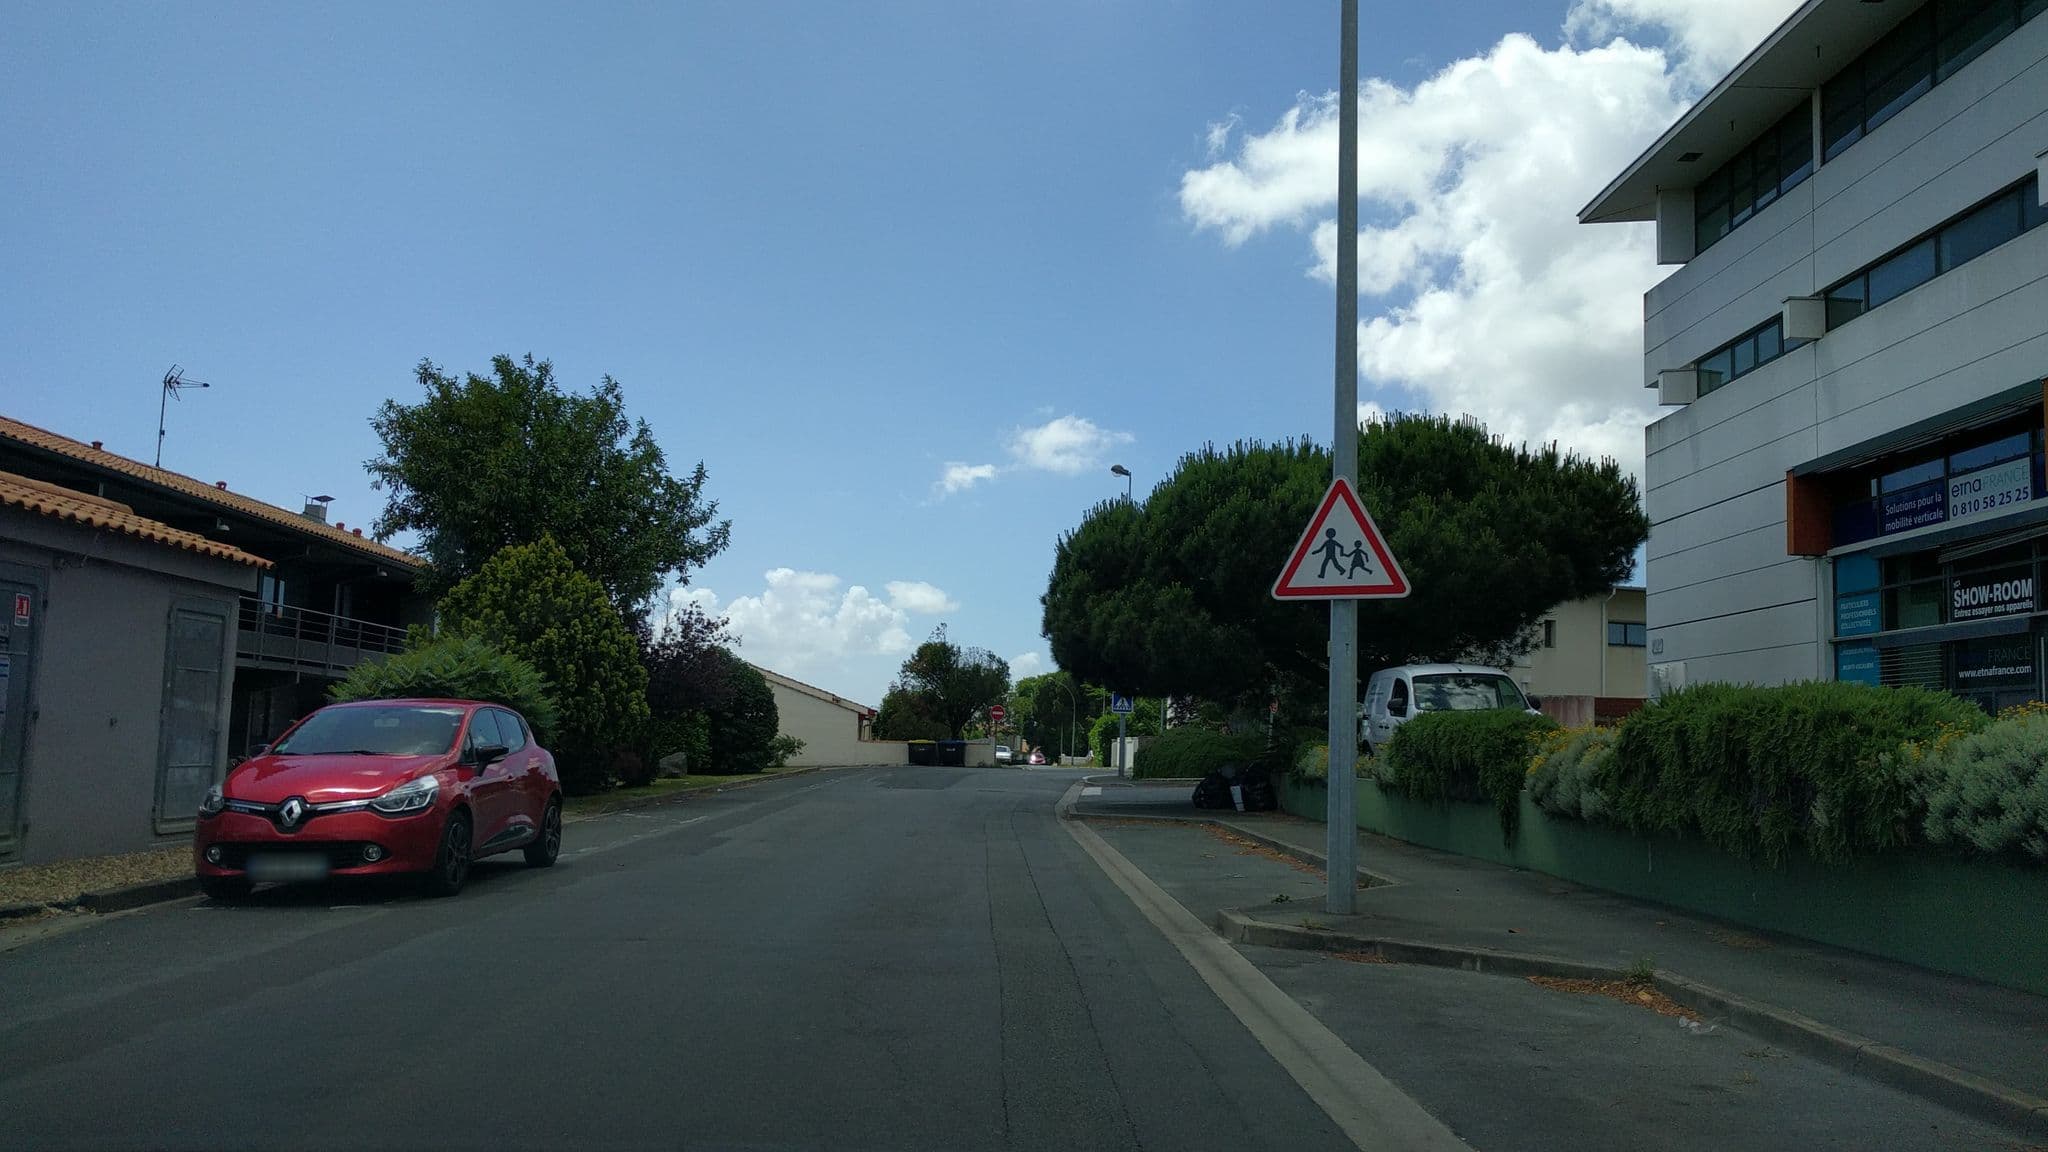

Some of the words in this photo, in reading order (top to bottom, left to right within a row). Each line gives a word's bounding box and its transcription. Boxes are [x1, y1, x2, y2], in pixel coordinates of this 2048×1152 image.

[1982, 465, 2028, 488] FRANCE
[1885, 500, 1917, 516] Solutions
[1917, 495, 1934, 511] pour
[1935, 491, 1942, 503] la
[1952, 504, 1958, 517] 0
[1960, 498, 1980, 515] 810
[1982, 494, 1996, 510] 58
[1998, 490, 2012, 506] 25
[2015, 486, 2029, 502] 25
[1885, 515, 1913, 532] mobilité
[1913, 508, 1944, 524] verticale
[1953, 579, 2033, 607] SHOW-ROOM
[1954, 608, 1971, 618] Entrez
[1971, 606, 1994, 617] essayer
[1994, 604, 2005, 612] nos
[2006, 600, 2033, 613] appareils
[1987, 646, 2032, 664] FRANCE
[1958, 665, 2032, 679] www.etnafrance.com
